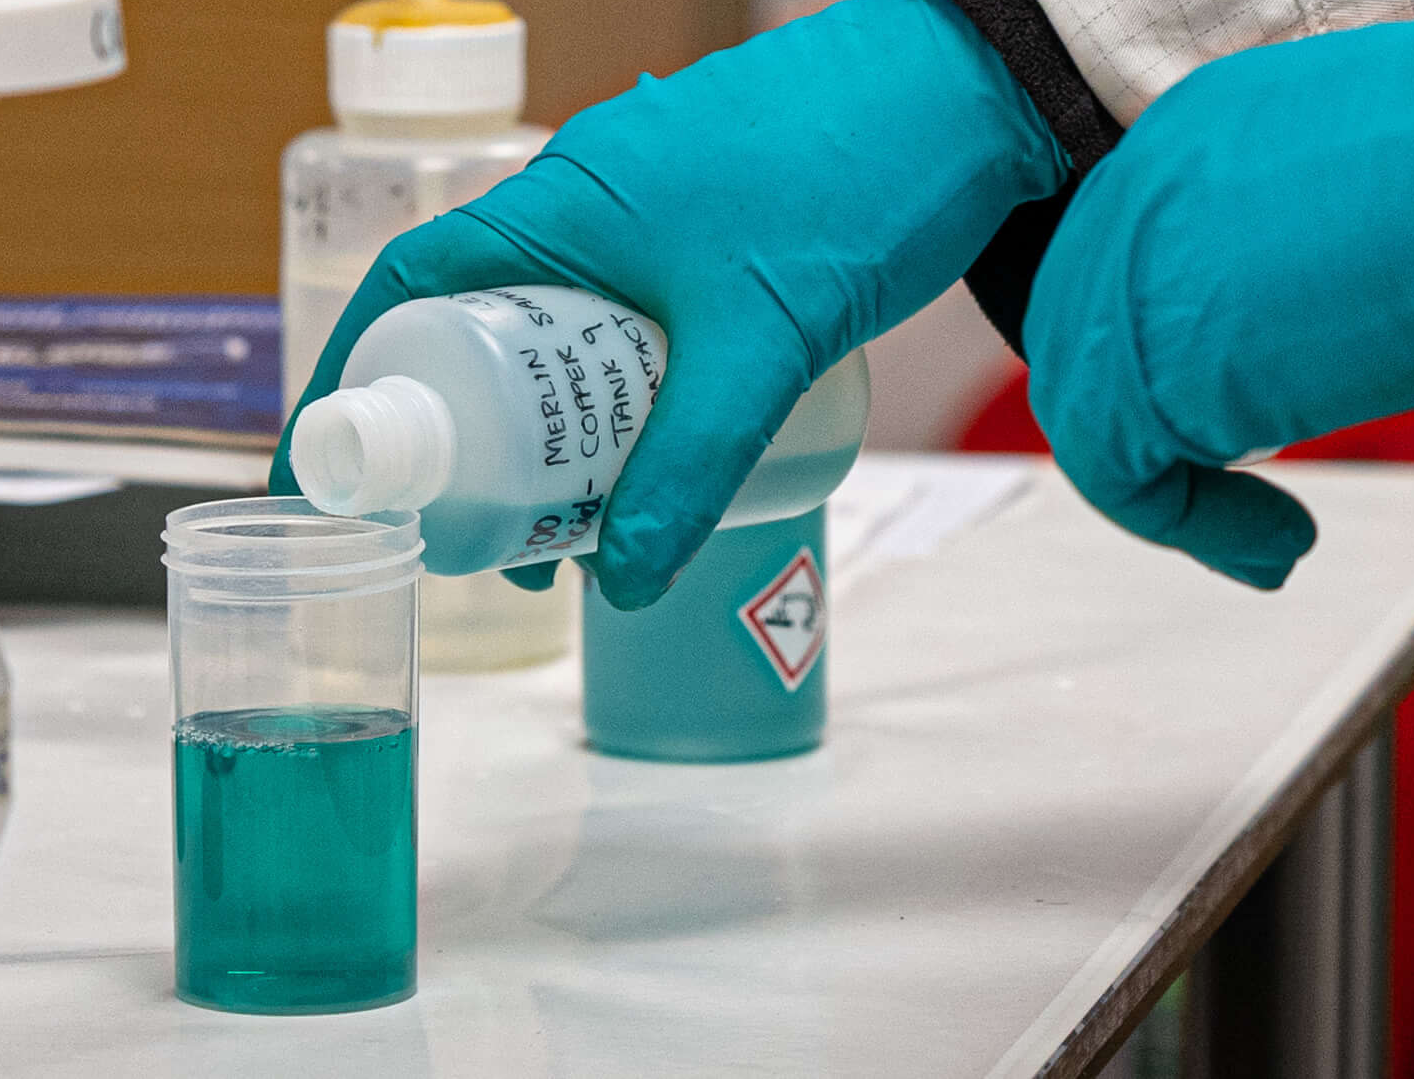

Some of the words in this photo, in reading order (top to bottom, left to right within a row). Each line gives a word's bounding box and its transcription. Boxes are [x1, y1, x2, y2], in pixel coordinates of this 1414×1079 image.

[581, 322, 603, 345] 9
[519, 348, 570, 467] MERLIN
[555, 345, 600, 458] COPPER
[600, 358, 634, 449] TANK
